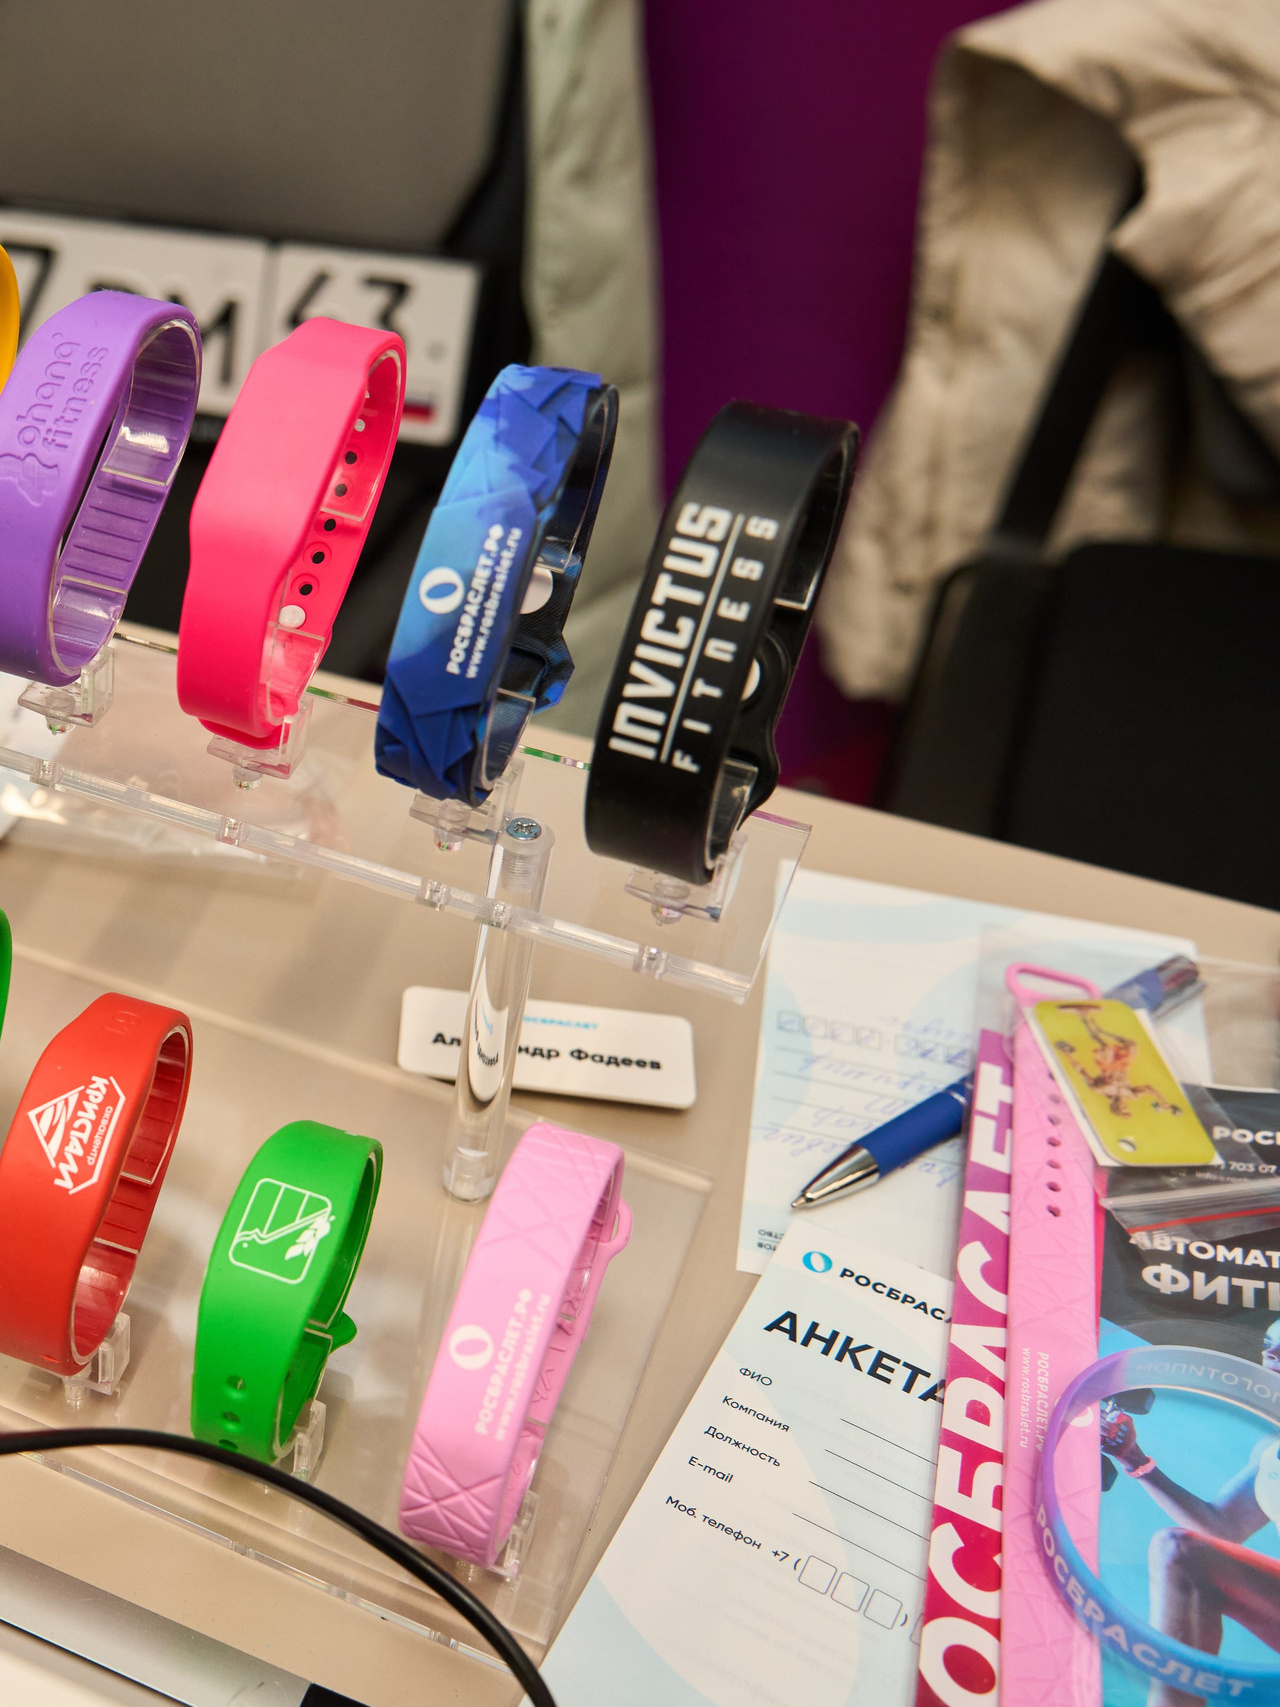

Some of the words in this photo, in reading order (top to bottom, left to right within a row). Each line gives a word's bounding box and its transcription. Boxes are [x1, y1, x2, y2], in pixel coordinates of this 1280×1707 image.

[42, 346, 110, 452] fitness
[608, 502, 733, 761] INVICTUS
[671, 516, 780, 774] FITNESS
[432, 1032, 560, 1060] Алндр
[570, 1047, 661, 1071] Фадеев
[87, 1106, 113, 1166] аквацентр
[1212, 1125, 1280, 1146] РОС
[839, 1267, 952, 1323] РОСБРАС
[739, 1367, 773, 1387] ФИО
[763, 1310, 947, 1404] АНКЕТА
[722, 1395, 790, 1433] Компания
[1020, 1347, 1032, 1448] www.rosbraslet.ru
[688, 1455, 734, 1483] E-mail
[704, 1425, 781, 1467] Должность
[665, 1495, 698, 1519] Моб.
[702, 1514, 762, 1550] телефон
[1037, 1503, 1254, 1697] РОСБРАСЛЕТ
